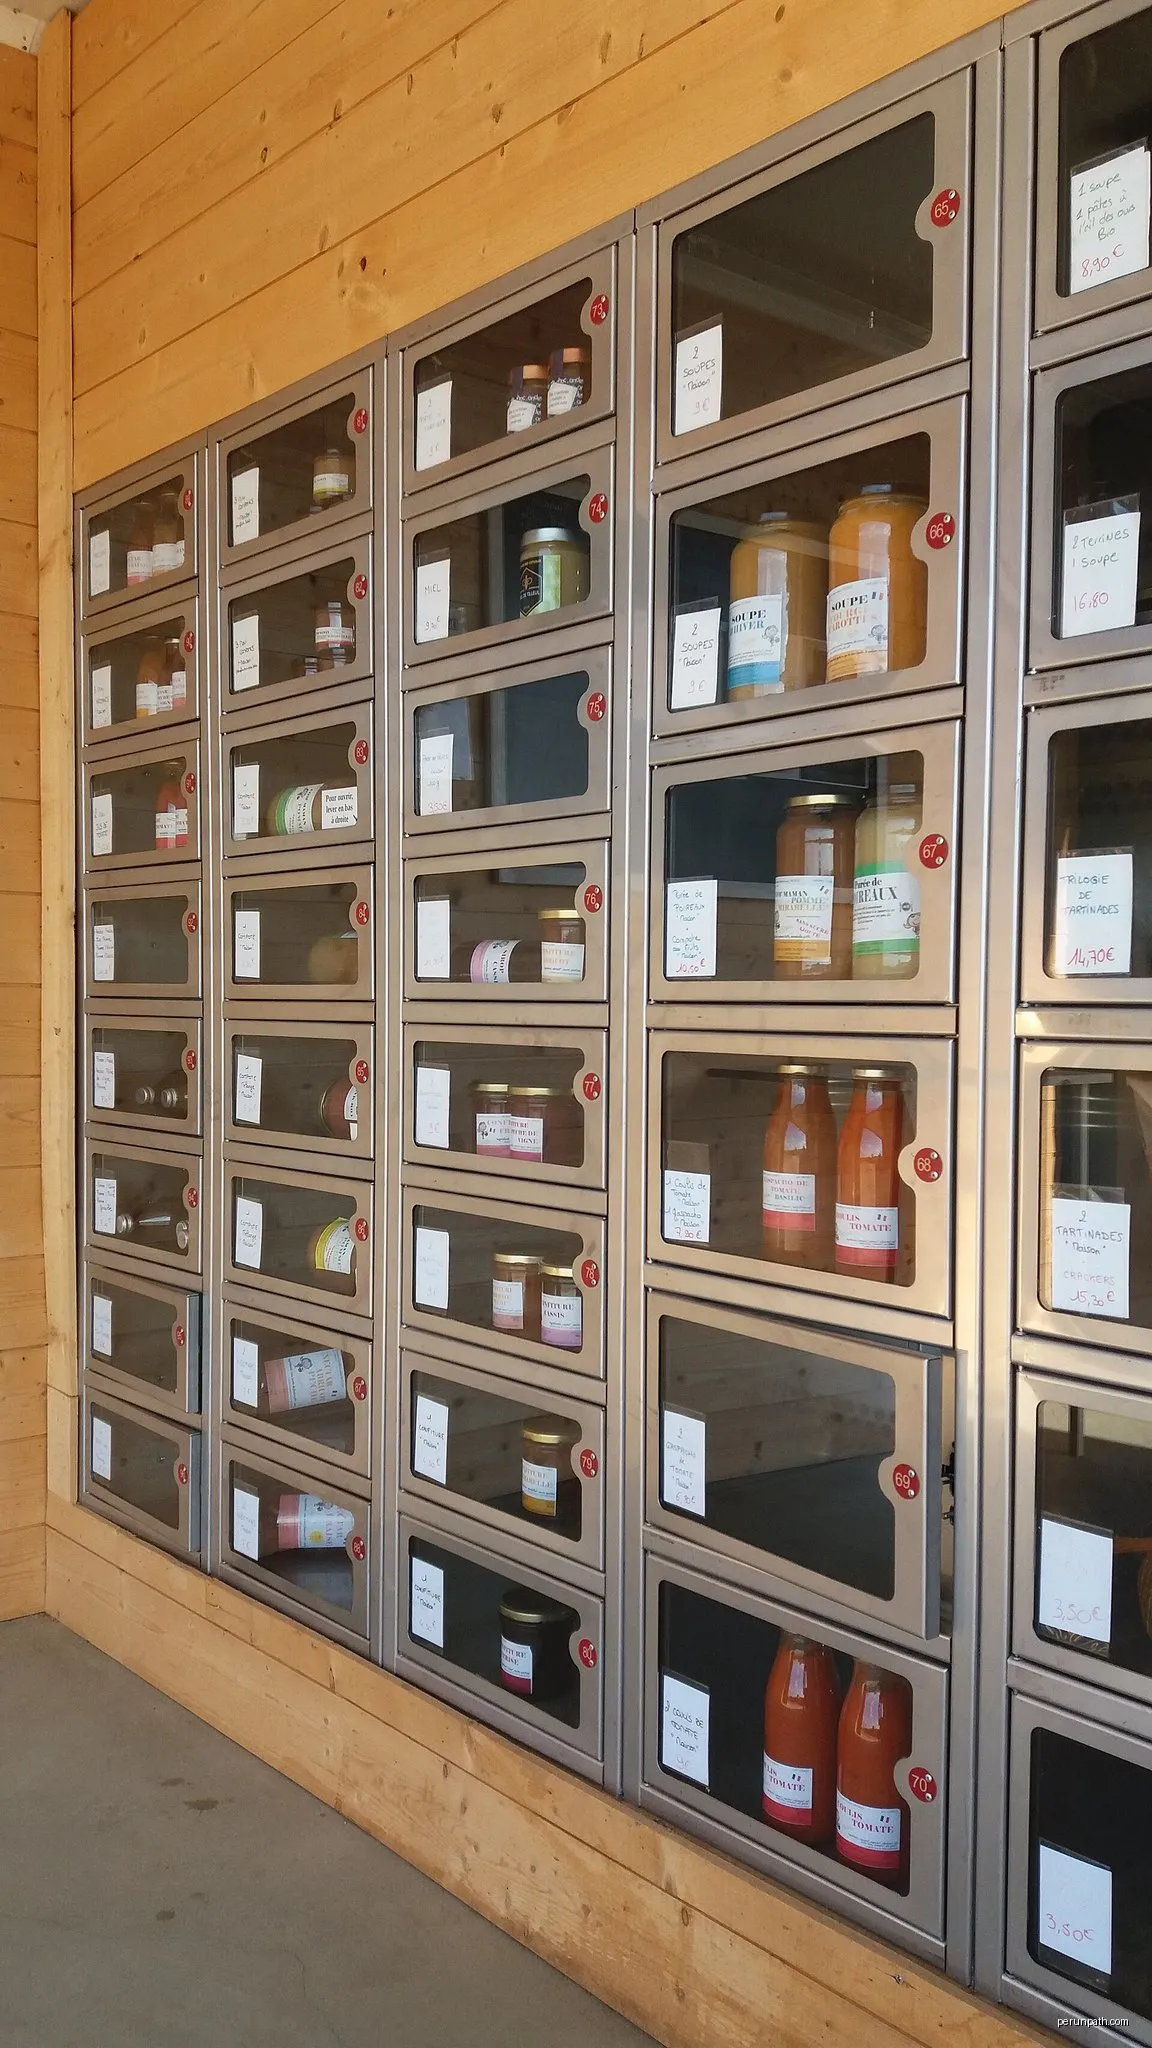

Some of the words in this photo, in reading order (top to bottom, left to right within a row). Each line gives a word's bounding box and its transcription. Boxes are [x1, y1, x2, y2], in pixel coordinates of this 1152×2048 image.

[934, 199, 949, 218] 65
[1097, 226, 1116, 241] Bio
[591, 302, 603, 318] 73
[692, 345, 699, 360] 2
[590, 501, 602, 517] 74
[929, 523, 944, 539] 66
[355, 581, 363, 594] 82
[424, 583, 442, 595] MIEL
[831, 594, 868, 612] SOUPE
[731, 609, 767, 624] SOUPE
[691, 623, 698, 636] 2
[589, 700, 600, 714] 75
[356, 746, 364, 758] 83
[325, 794, 337, 803] Pour
[337, 792, 354, 801] ouvrir,
[325, 805, 337, 814] lever
[338, 805, 344, 813] en
[344, 803, 354, 812] bas
[334, 815, 349, 824] droite
[922, 843, 938, 859] 67
[871, 877, 883, 887] de
[585, 892, 596, 906] 76
[1078, 890, 1092, 900] DE
[584, 1080, 595, 1093] 77
[917, 1157, 932, 1173] 68
[697, 1181, 707, 1191] de
[770, 1186, 801, 1194] TOMATE
[796, 1179, 808, 1187] DE
[1078, 1210, 1088, 1223] 2
[849, 1222, 892, 1232] TOMATE
[1055, 1226, 1124, 1243] TARTINADES
[585, 1266, 595, 1280] 78
[1063, 1270, 1117, 1286] CRACKERS
[581, 1455, 593, 1470] 79
[894, 1472, 911, 1490] 69
[354, 1541, 361, 1554] 88
[1052, 1598, 1104, 1625] 3,50€
[768, 1775, 806, 1792] TOMATE
[911, 1773, 928, 1793] 70
[851, 1818, 894, 1834] TOMATE
